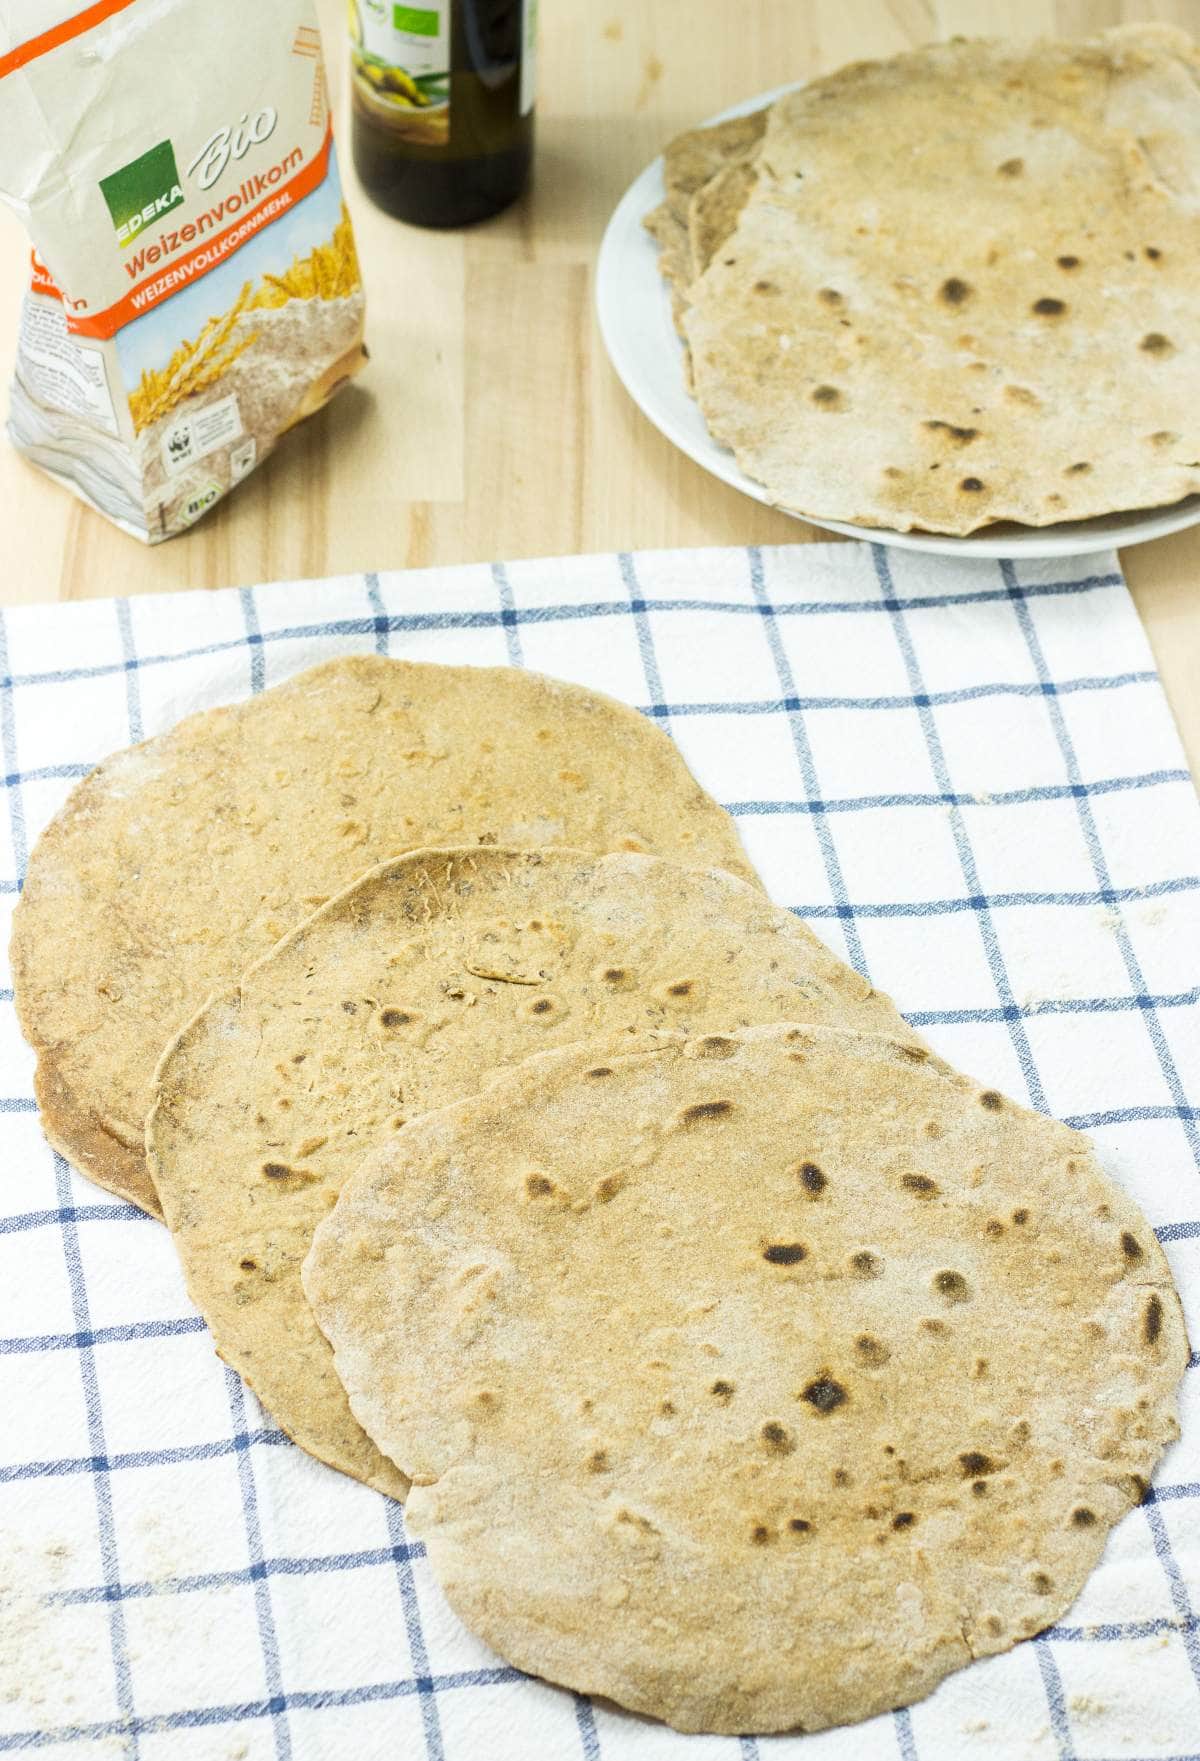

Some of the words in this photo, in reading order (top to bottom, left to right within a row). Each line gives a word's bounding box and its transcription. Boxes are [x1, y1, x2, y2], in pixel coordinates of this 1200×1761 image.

[188, 106, 278, 191] Bio
[116, 184, 184, 241] EDEKA
[131, 192, 293, 309] WEIZENVOLLKORNMEHL
